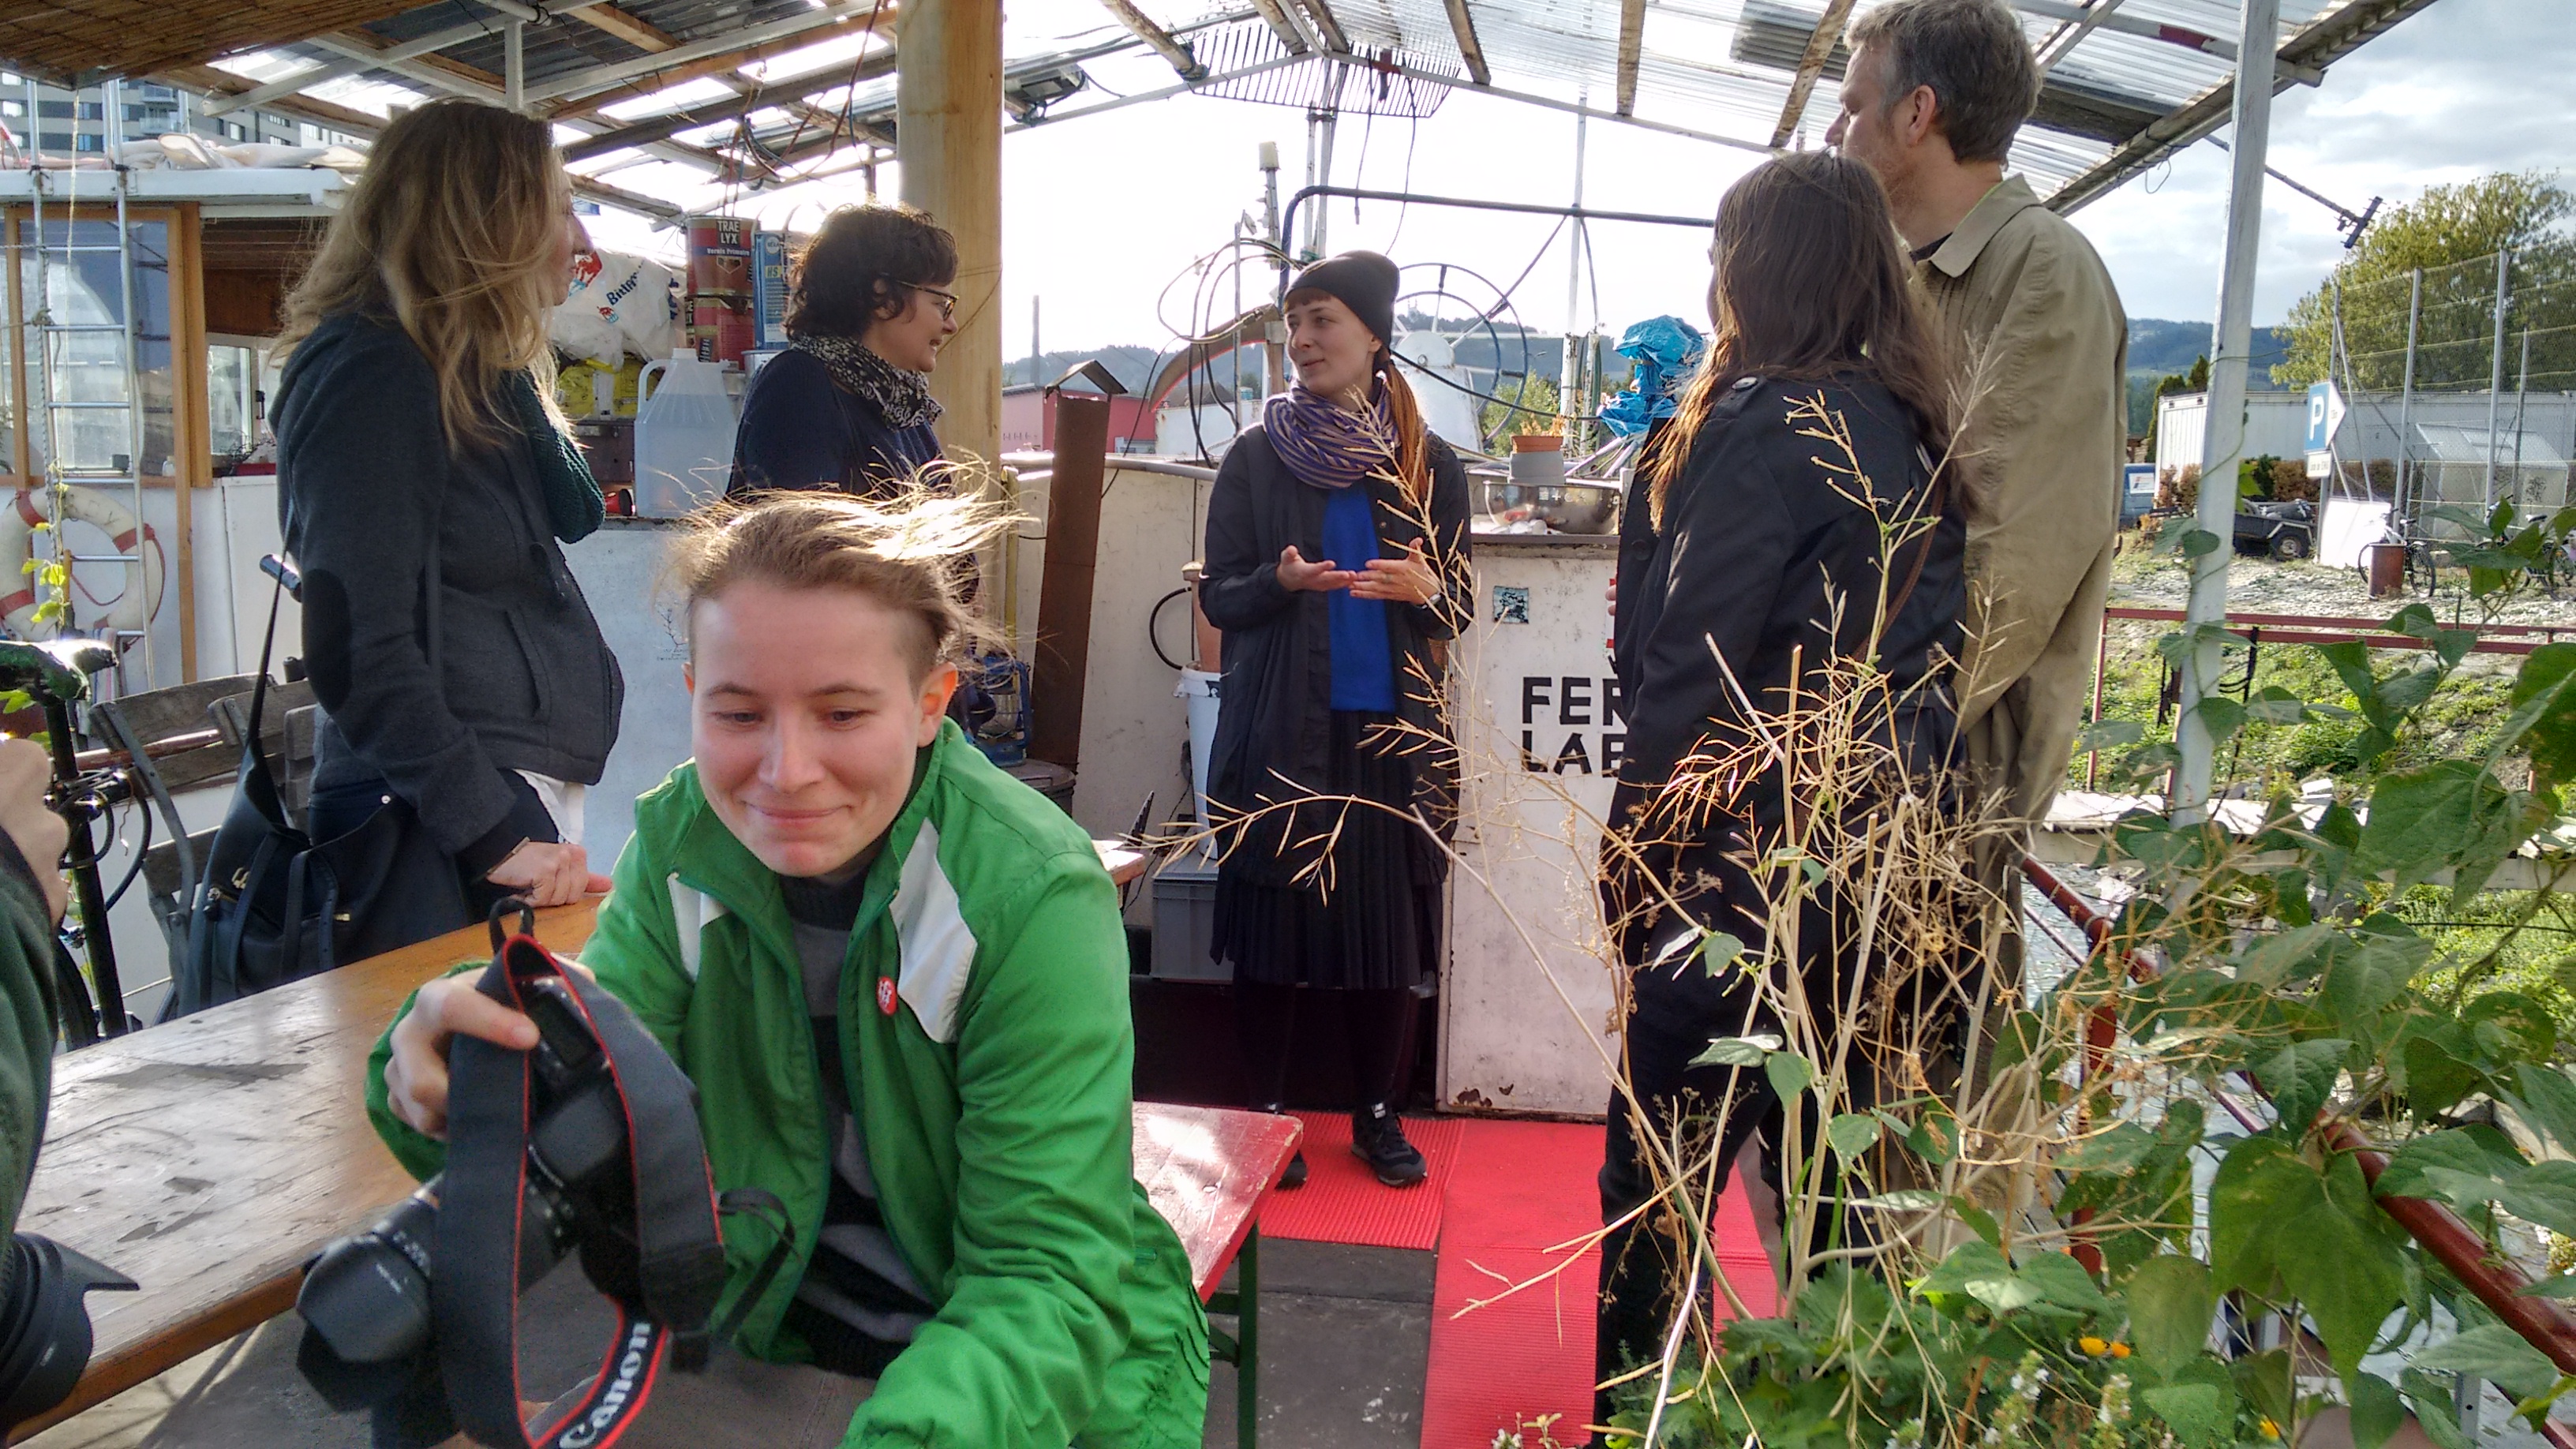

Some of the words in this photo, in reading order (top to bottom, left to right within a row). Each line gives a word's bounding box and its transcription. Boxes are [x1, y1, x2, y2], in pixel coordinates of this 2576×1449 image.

[717, 220, 739, 232] TRAE
[721, 233, 737, 245] LYX
[726, 248, 750, 256] Primaire
[767, 267, 778, 277] HS
[2309, 395, 2324, 441] P
[559, 1323, 651, 1449] Canon
